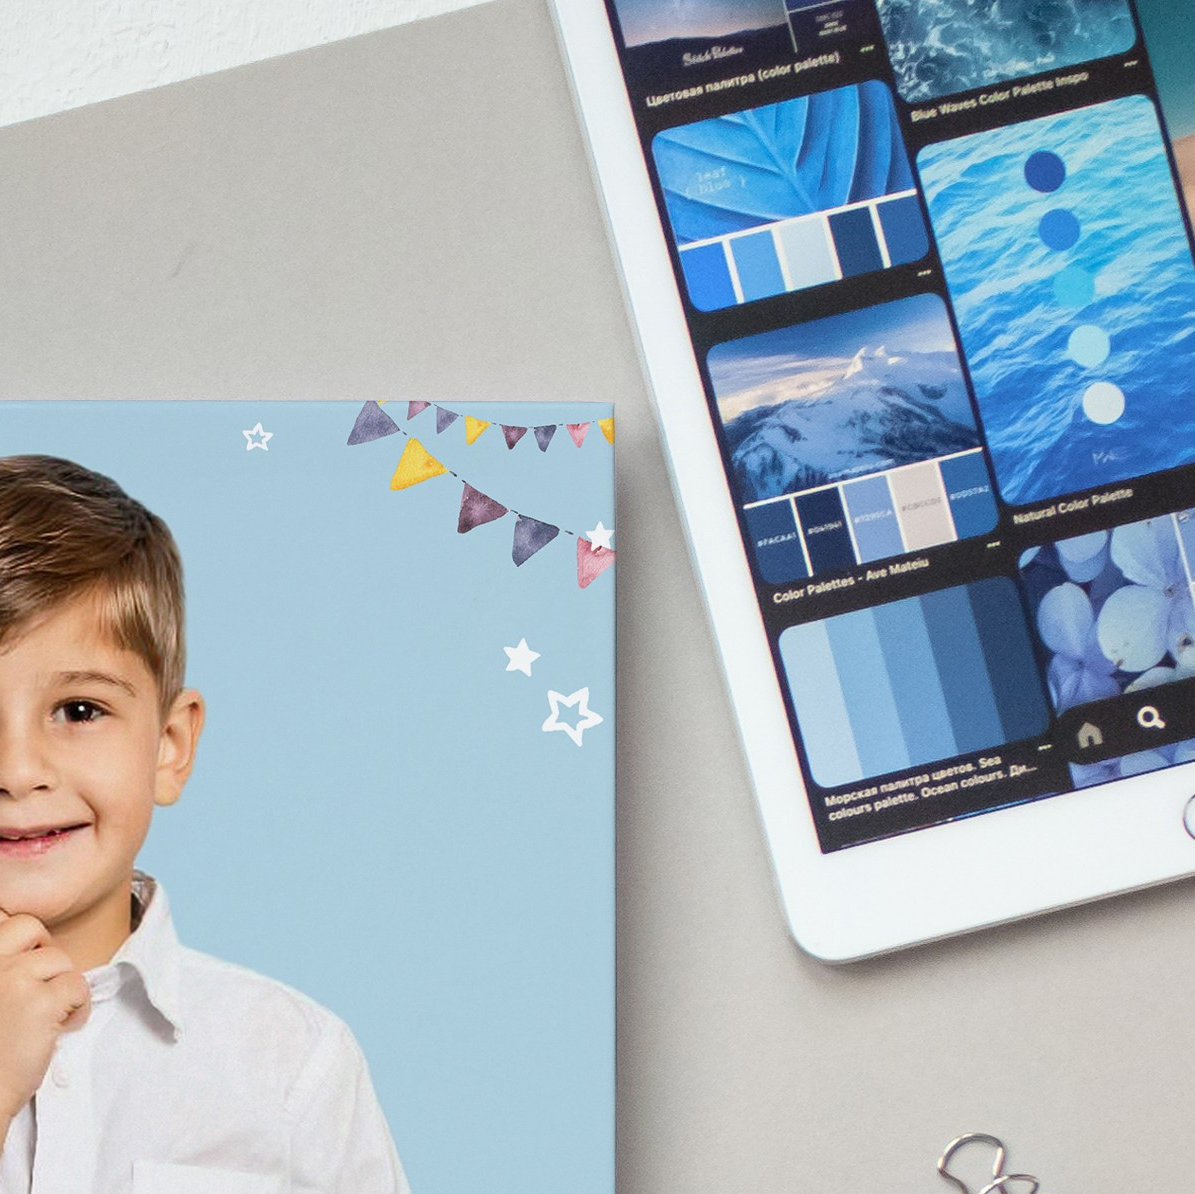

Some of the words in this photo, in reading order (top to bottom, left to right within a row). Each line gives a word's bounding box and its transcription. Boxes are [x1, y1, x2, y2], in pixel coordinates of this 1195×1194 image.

[646, 86, 704, 107] Цветовая
[705, 74, 755, 94] палитра
[758, 64, 792, 82] (color
[794, 51, 841, 73] palette)
[911, 106, 938, 122] Blue
[938, 97, 977, 115] Waves
[979, 90, 1010, 106] Color
[1012, 79, 1054, 98] Palette
[1013, 505, 1056, 525] Natural
[1058, 497, 1090, 514] Color
[1091, 487, 1134, 506] Palette
[773, 588, 804, 604] Color
[807, 574, 856, 595] Palettes
[866, 567, 888, 581] Ave
[824, 786, 878, 807] Морская
[880, 773, 930, 794] палитра
[931, 764, 977, 782] цветов.
[978, 755, 1002, 769] Sea
[829, 803, 872, 821] colours
[874, 791, 919, 812] palette.
[921, 781, 959, 799] Ocean
[960, 770, 1008, 788] colours.
